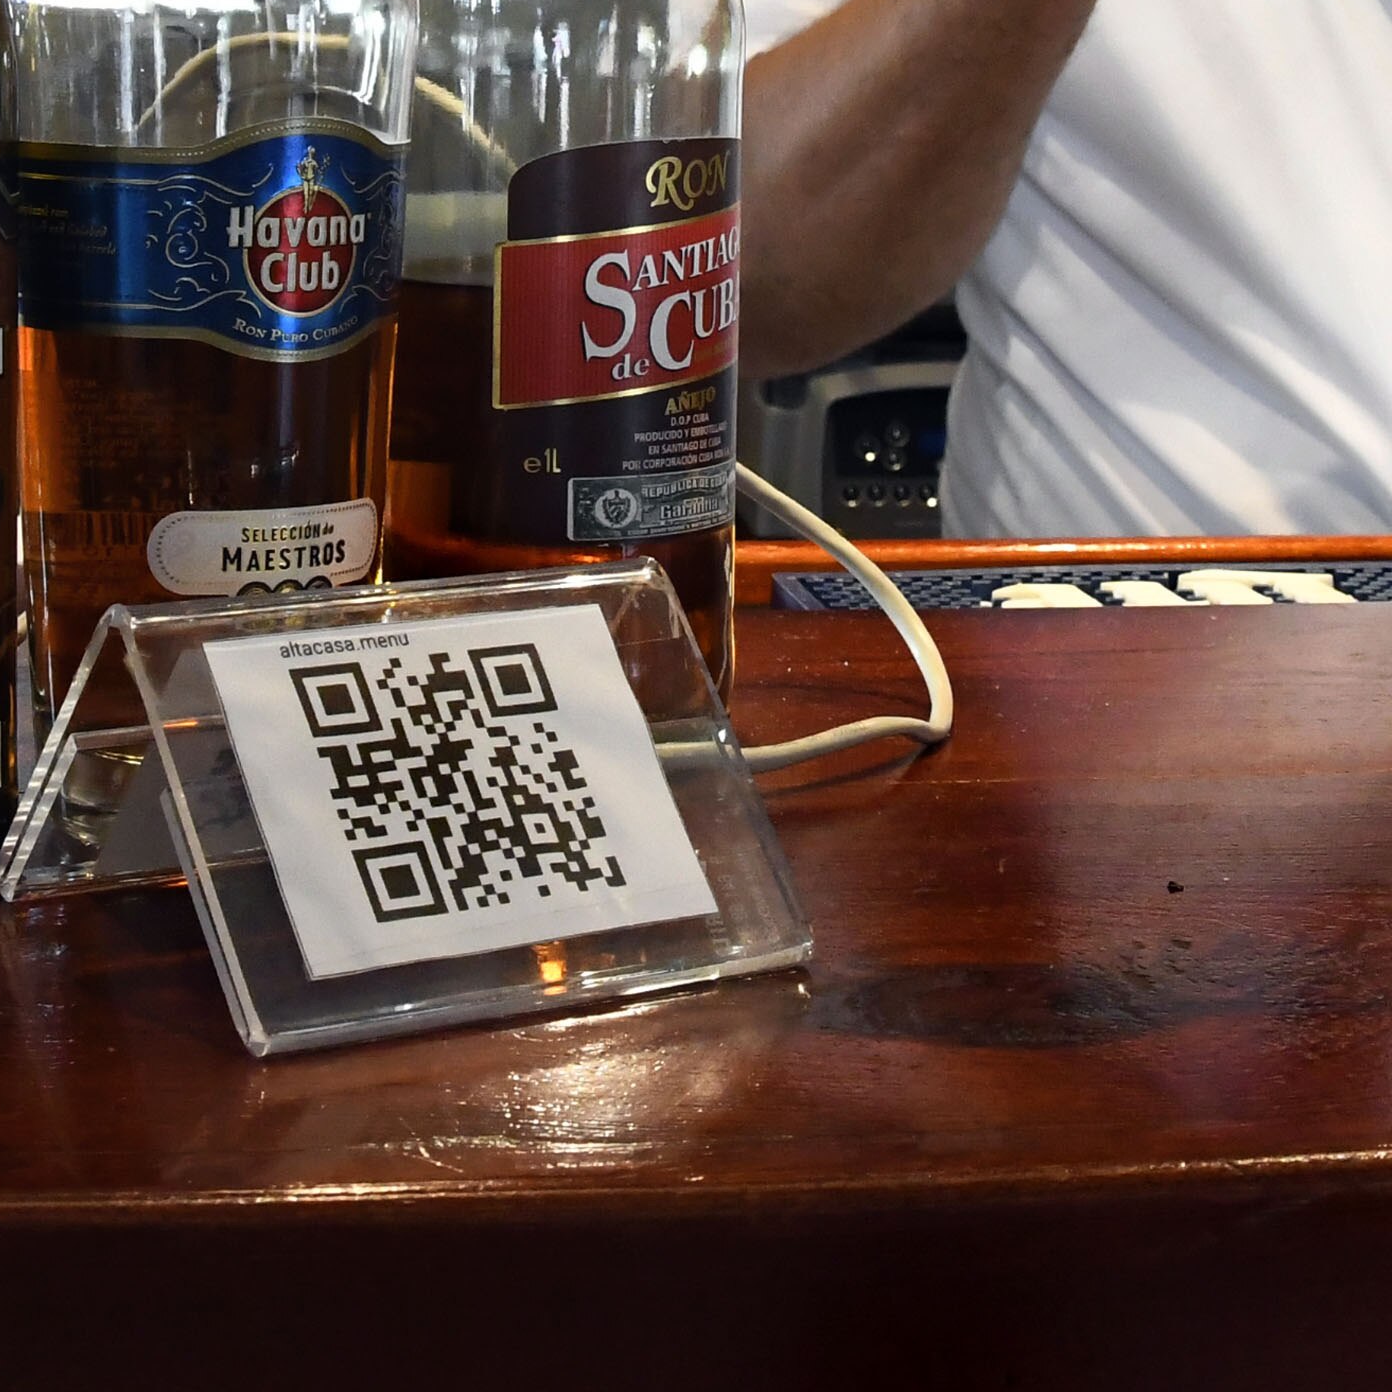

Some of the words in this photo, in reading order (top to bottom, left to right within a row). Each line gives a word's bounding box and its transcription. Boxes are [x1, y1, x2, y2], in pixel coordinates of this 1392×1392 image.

[644, 149, 731, 211] RON
[225, 204, 367, 249] Havana
[260, 251, 341, 293] Club
[580, 228, 741, 362] SANTIAG
[232, 316, 266, 339] RON
[269, 326, 308, 343] PURO
[649, 278, 740, 371] CUB
[612, 352, 651, 381] de
[664, 386, 716, 416] AÑEJO
[692, 412, 710, 424] CUBA
[634, 429, 682, 442] PRODUCIDO
[648, 443, 660, 456] EN
[661, 439, 699, 455] SANTIAGO
[544, 448, 562, 475] 1L
[642, 453, 698, 471] CORPORACIÓN
[241, 521, 321, 543] SELECCIÓN
[220, 539, 346, 573] MAESTROS
[279, 631, 411, 659] altacasa.menu
